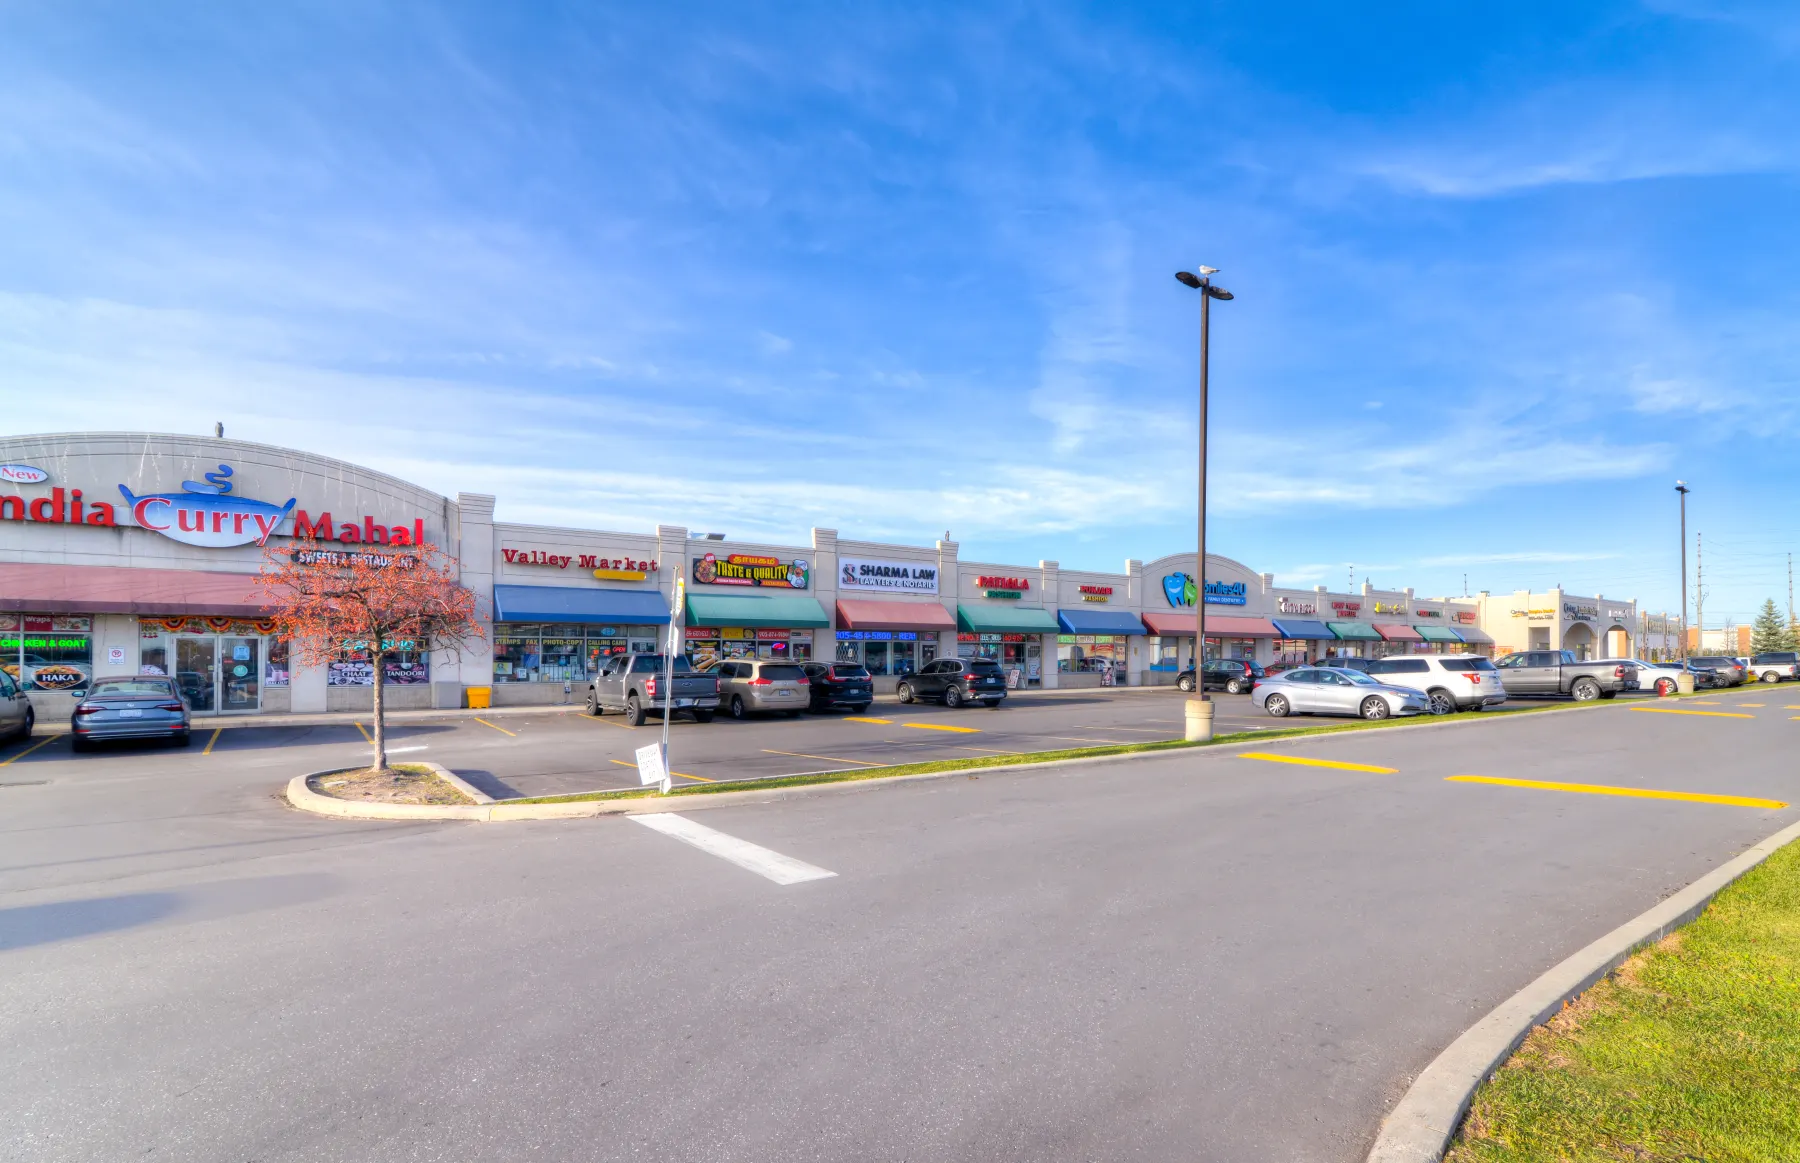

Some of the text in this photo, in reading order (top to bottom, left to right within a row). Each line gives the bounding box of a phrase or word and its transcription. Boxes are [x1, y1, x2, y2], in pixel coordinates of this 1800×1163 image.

[2, 467, 40, 480] New
[134, 497, 280, 547] Curry
[293, 509, 424, 545] Mahal
[501, 548, 658, 572] Valley Market
[715, 559, 744, 577] TASTE
[753, 565, 788, 581] QUALITY
[860, 564, 936, 580] SHARMA LAW
[860, 577, 936, 589] LAWYERS & NOTARIES
[979, 575, 1030, 590] PATIALA
[1080, 585, 1113, 595] PUNJABI
[25, 615, 52, 623] Wraps
[49, 639, 56, 648] &
[58, 639, 87, 648] GOAT
[42, 674, 75, 682] HAKA
[341, 670, 367, 678] CHAAT
